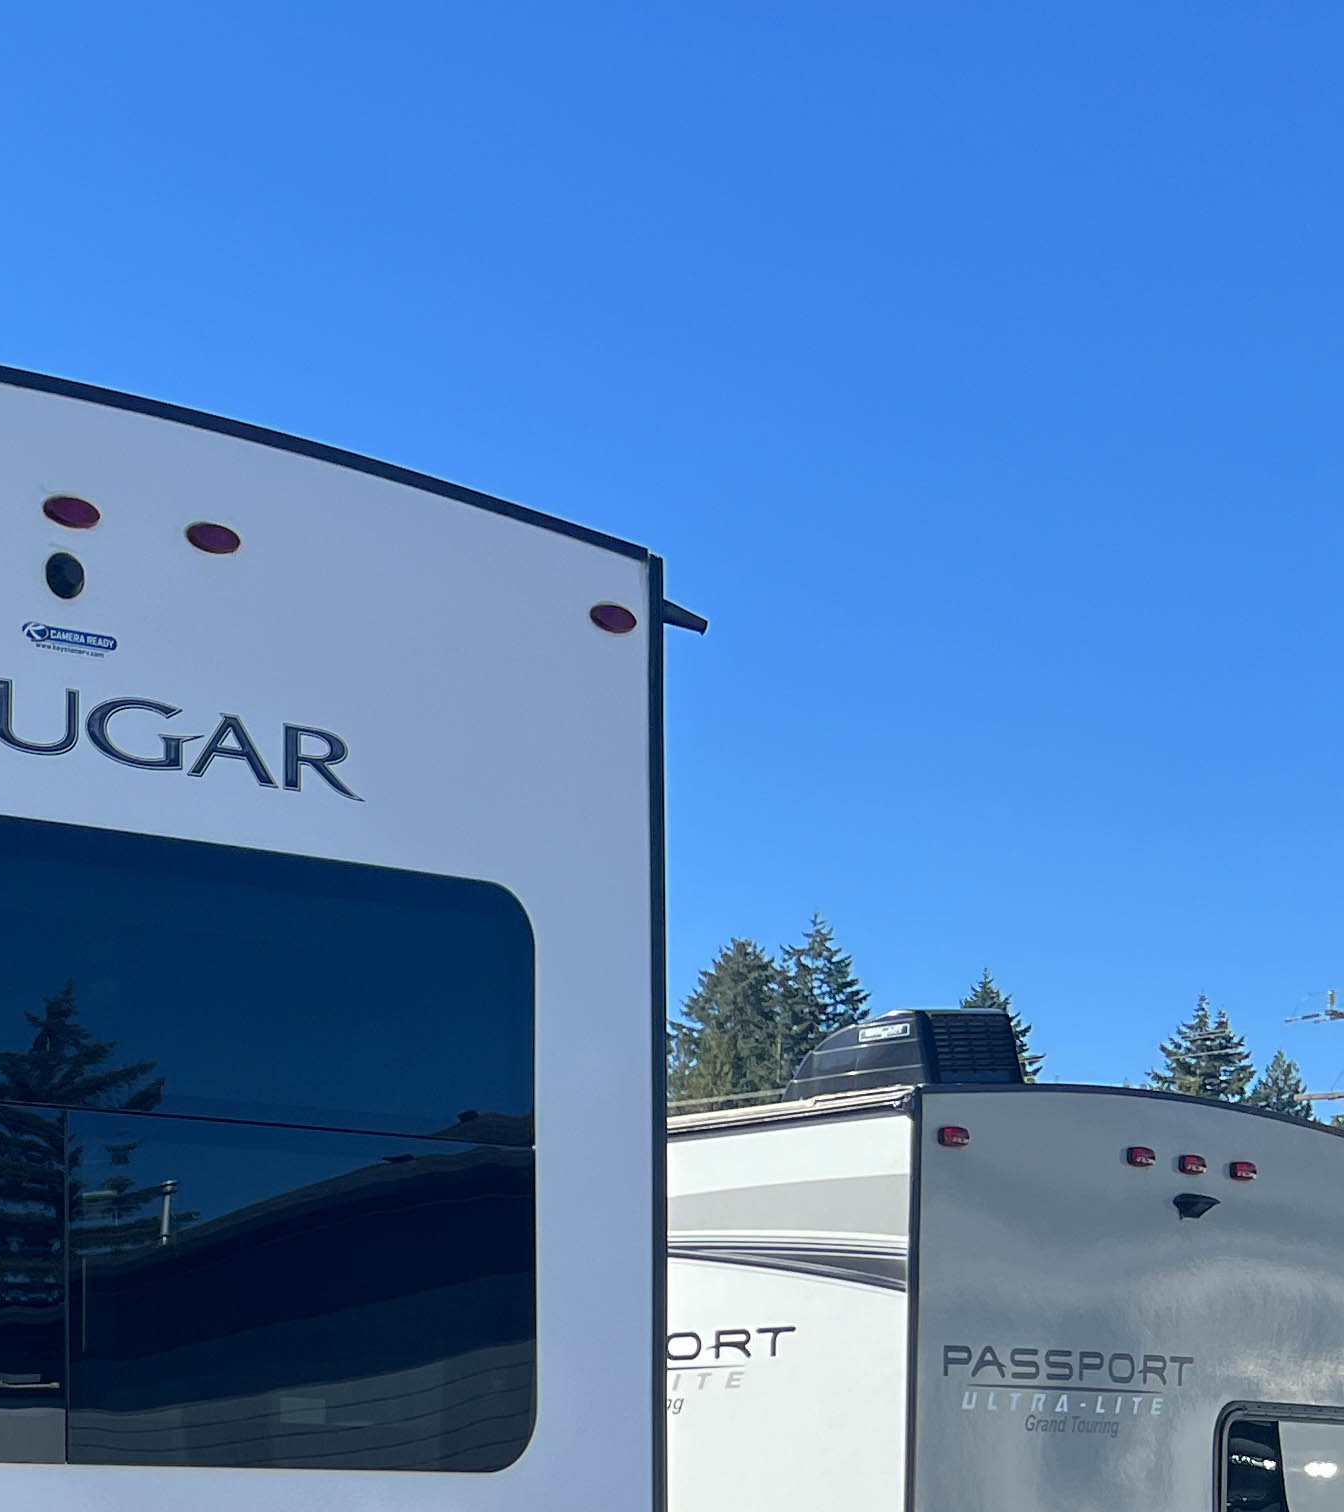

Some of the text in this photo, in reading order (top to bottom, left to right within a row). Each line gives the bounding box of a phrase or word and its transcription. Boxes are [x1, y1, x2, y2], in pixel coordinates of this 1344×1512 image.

[50, 629, 115, 649] CAMERA READY
[943, 1345, 1194, 1386] PASSPORT
[962, 1391, 1164, 1416] ULTRA-LITE
[1025, 1414, 1120, 1438] Grand Touring
